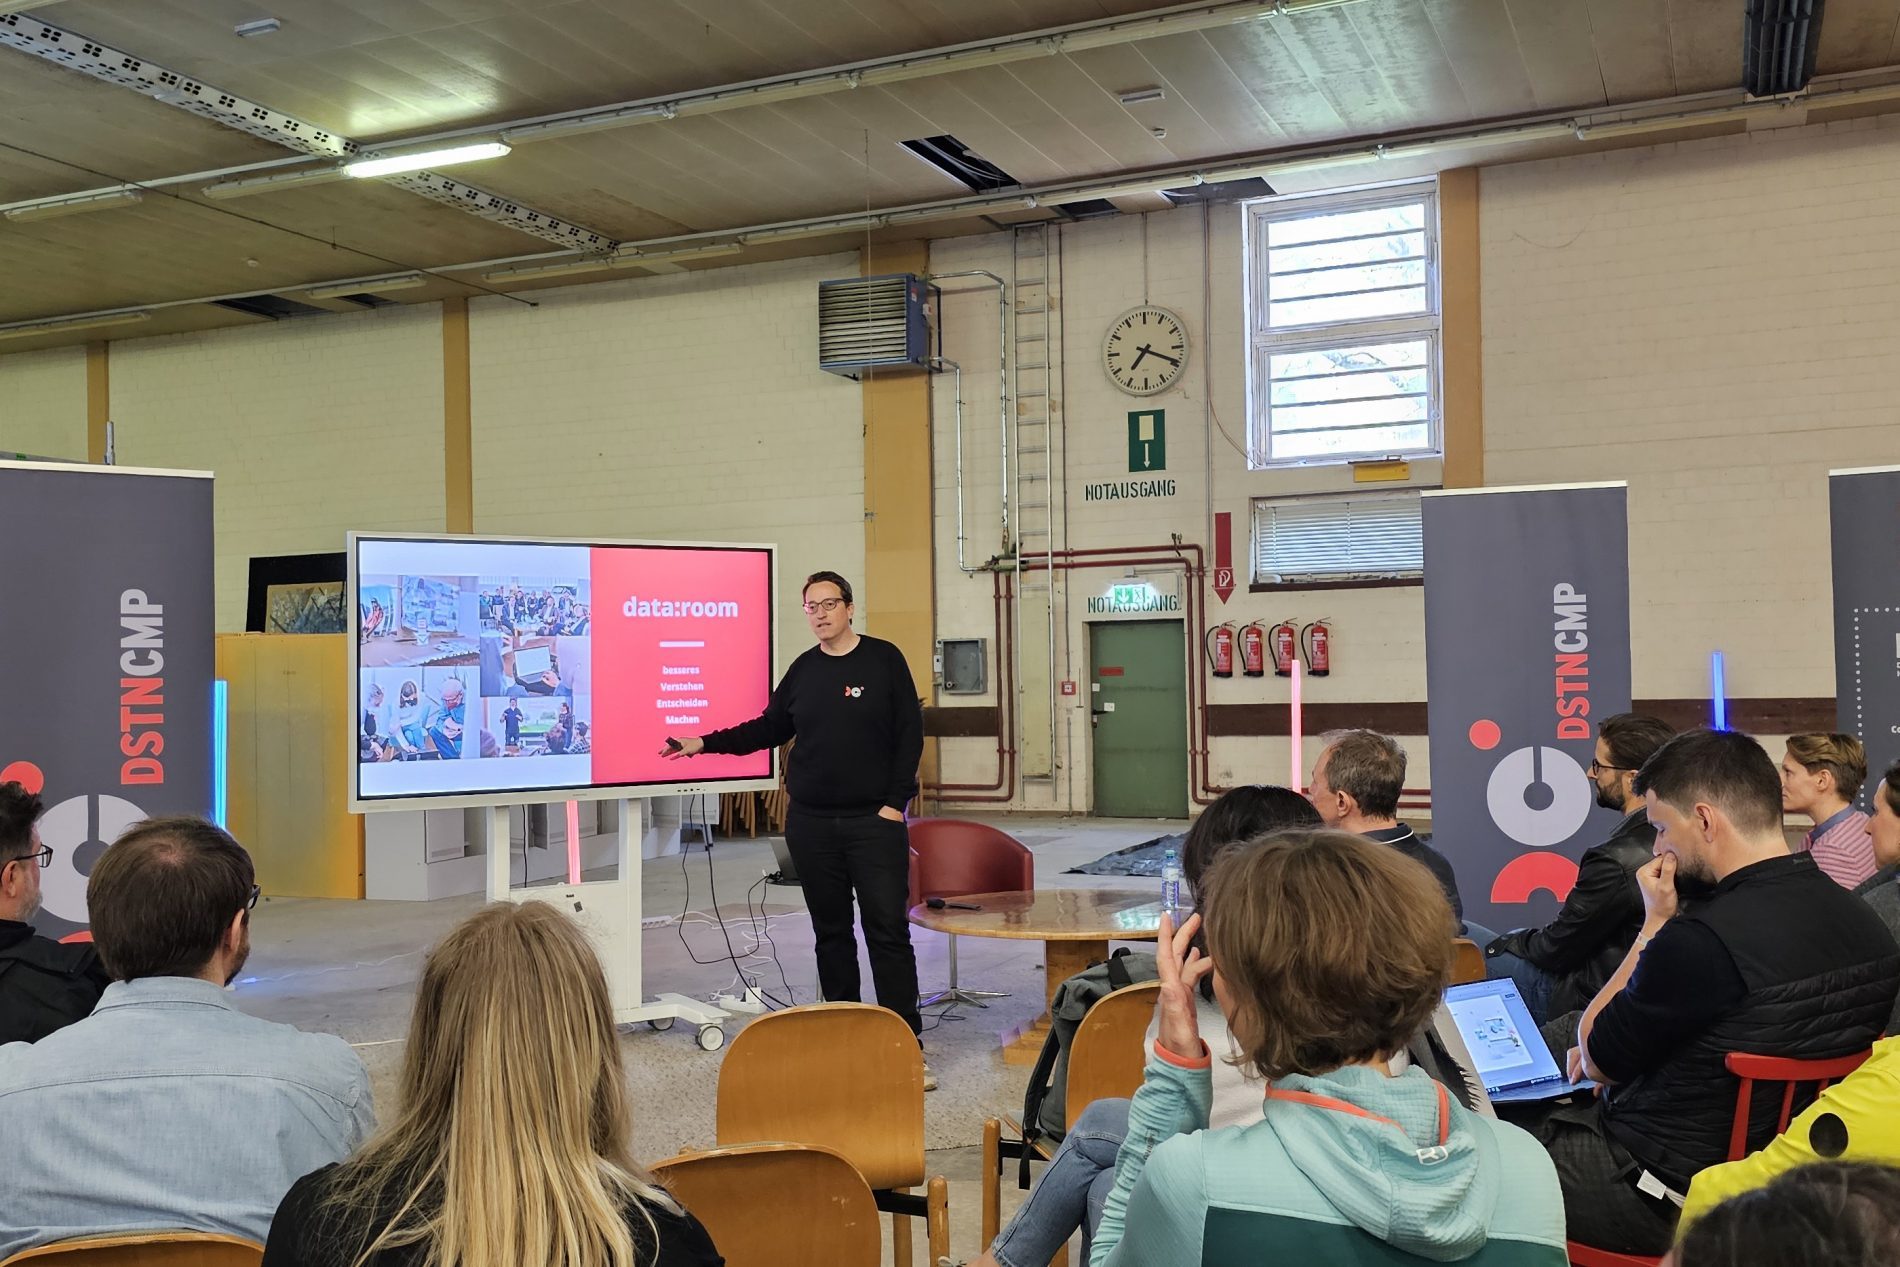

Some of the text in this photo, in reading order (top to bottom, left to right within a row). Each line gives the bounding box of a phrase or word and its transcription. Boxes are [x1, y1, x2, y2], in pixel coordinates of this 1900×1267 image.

[1085, 480, 1176, 501] NOTAUSGANG
[623, 596, 738, 617] data:room
[1553, 582, 1590, 739] DSTNCMP
[662, 666, 700, 675] besseres
[121, 589, 164, 784] DSTNCMP
[660, 682, 704, 692] Verstehen
[656, 698, 708, 708] Entscheiden
[665, 715, 700, 725] Machen
